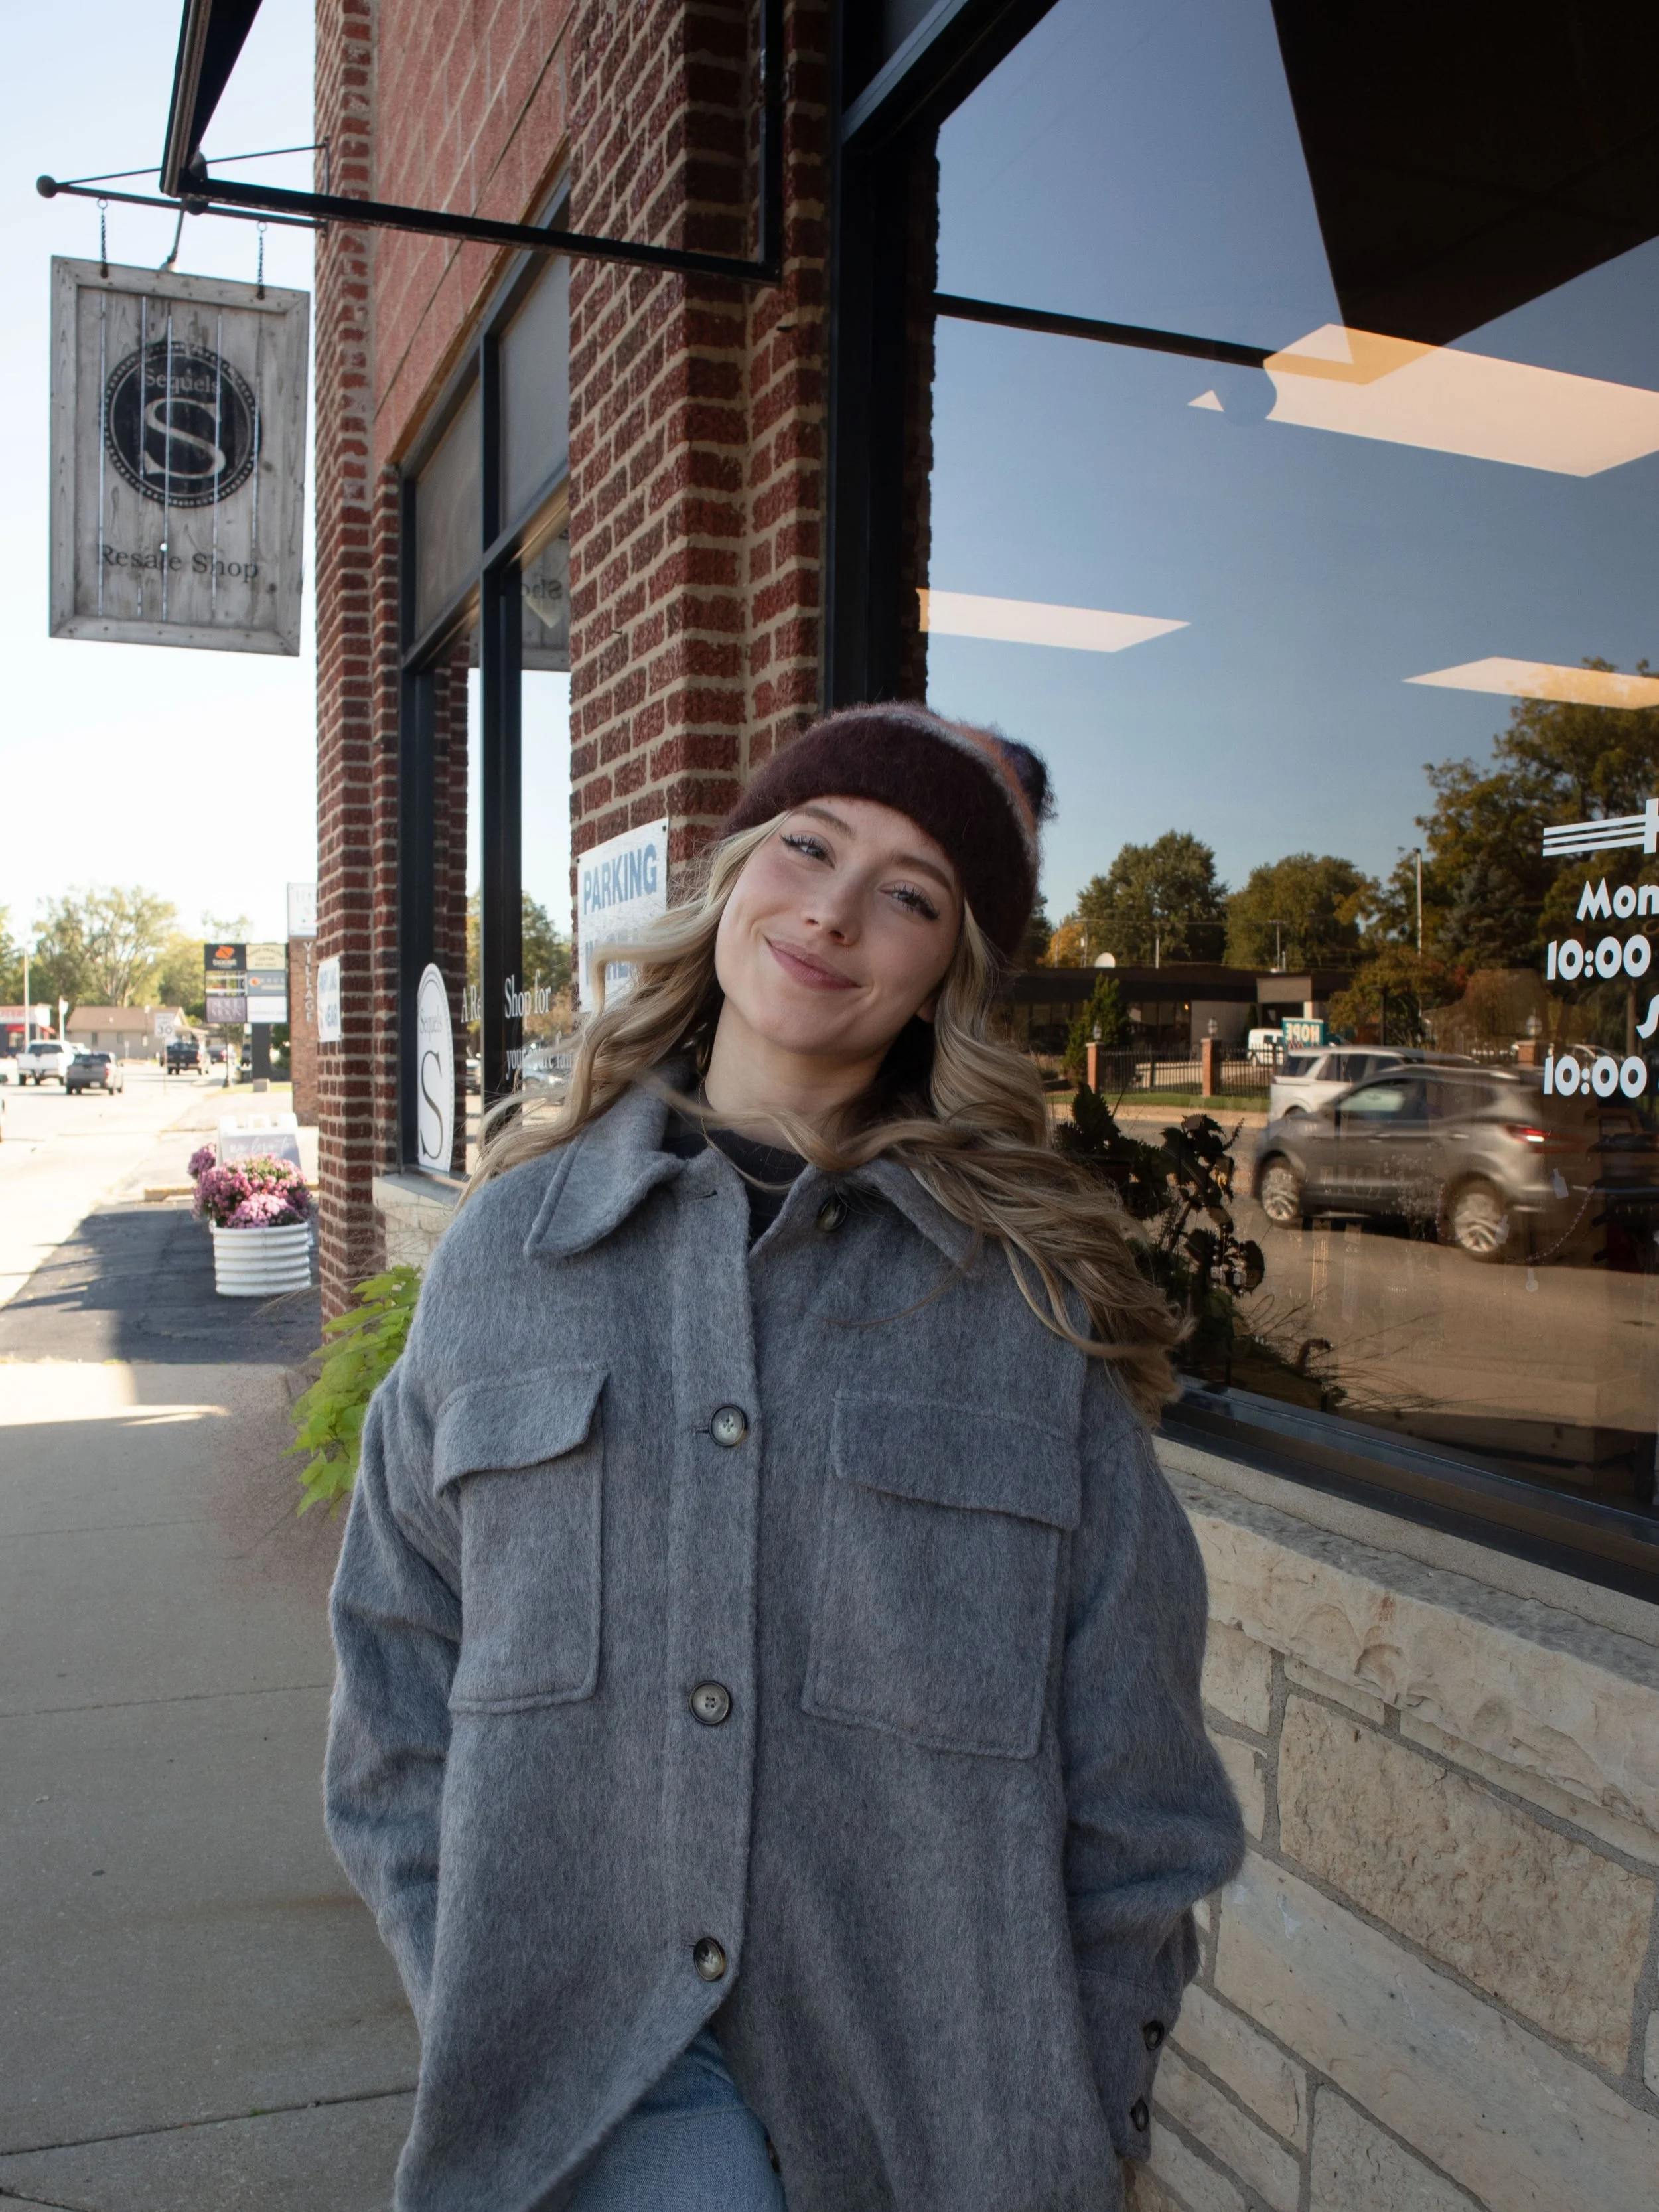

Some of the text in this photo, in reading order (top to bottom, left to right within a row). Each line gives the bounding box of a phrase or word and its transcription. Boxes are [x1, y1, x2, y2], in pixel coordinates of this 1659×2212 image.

[143, 368, 224, 394] Sequels
[142, 397, 227, 479] S
[98, 544, 259, 581] Resale Shop
[583, 844, 657, 915] PARKING
[303, 942, 315, 1023] VILLAGE
[1546, 934, 1651, 980] 10:00
[461, 987, 469, 1023] A
[505, 974, 532, 1030] Shop
[534, 968, 552, 1015] for
[505, 1047, 526, 1081] your
[1544, 1055, 1647, 1098] 10:00
[420, 1050, 443, 1160] S
